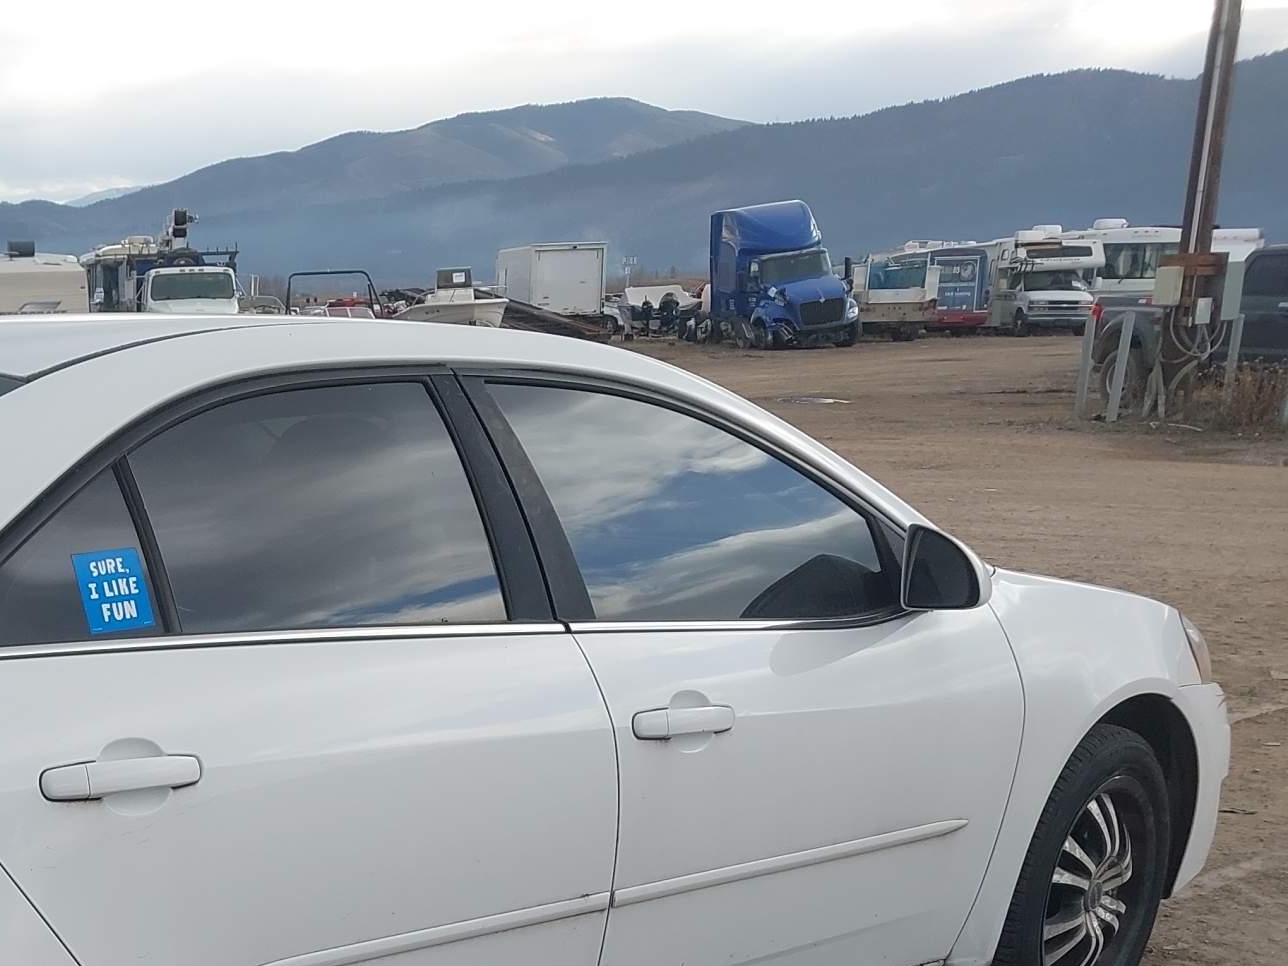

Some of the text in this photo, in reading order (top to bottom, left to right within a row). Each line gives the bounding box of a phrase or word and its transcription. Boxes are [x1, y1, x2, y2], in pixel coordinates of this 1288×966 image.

[89, 557, 130, 577] SURE,
[88, 576, 139, 599] I LIKE
[101, 599, 138, 623] FUN
